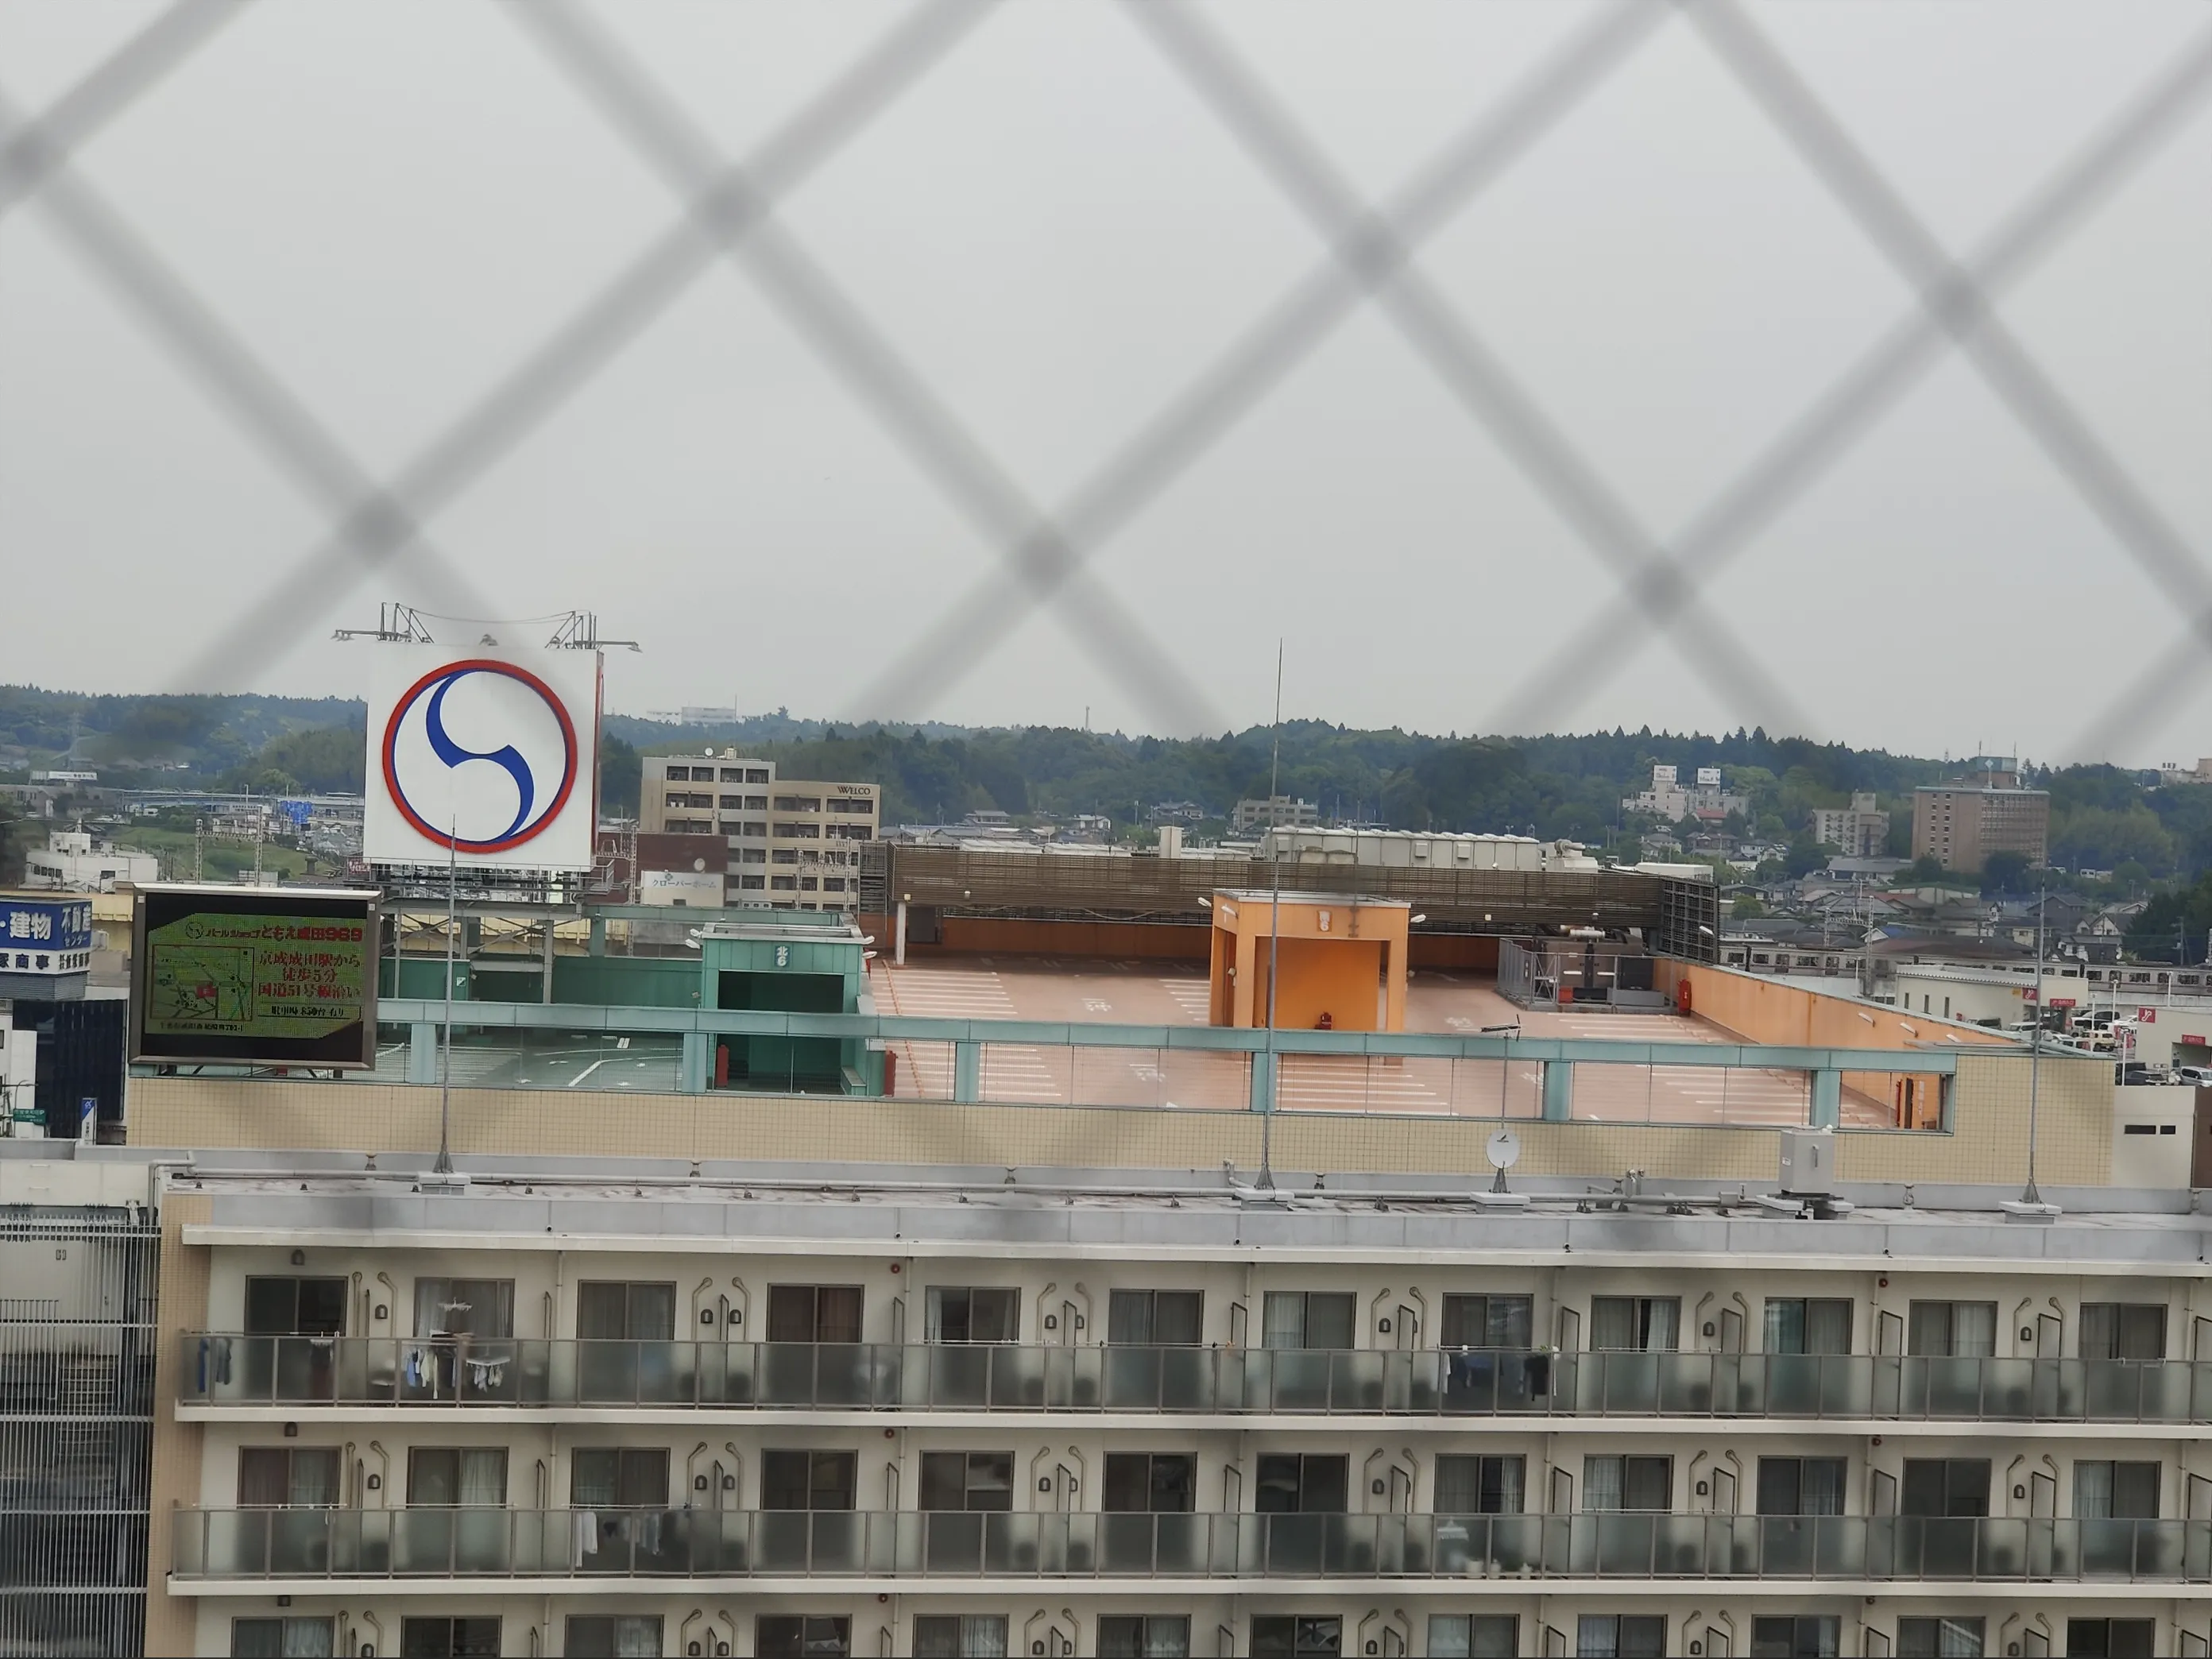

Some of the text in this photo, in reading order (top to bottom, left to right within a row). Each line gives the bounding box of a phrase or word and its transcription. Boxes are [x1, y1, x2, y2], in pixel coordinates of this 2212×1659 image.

[652, 880, 717, 888] クローバーホーム
[64, 935, 87, 947] センター
